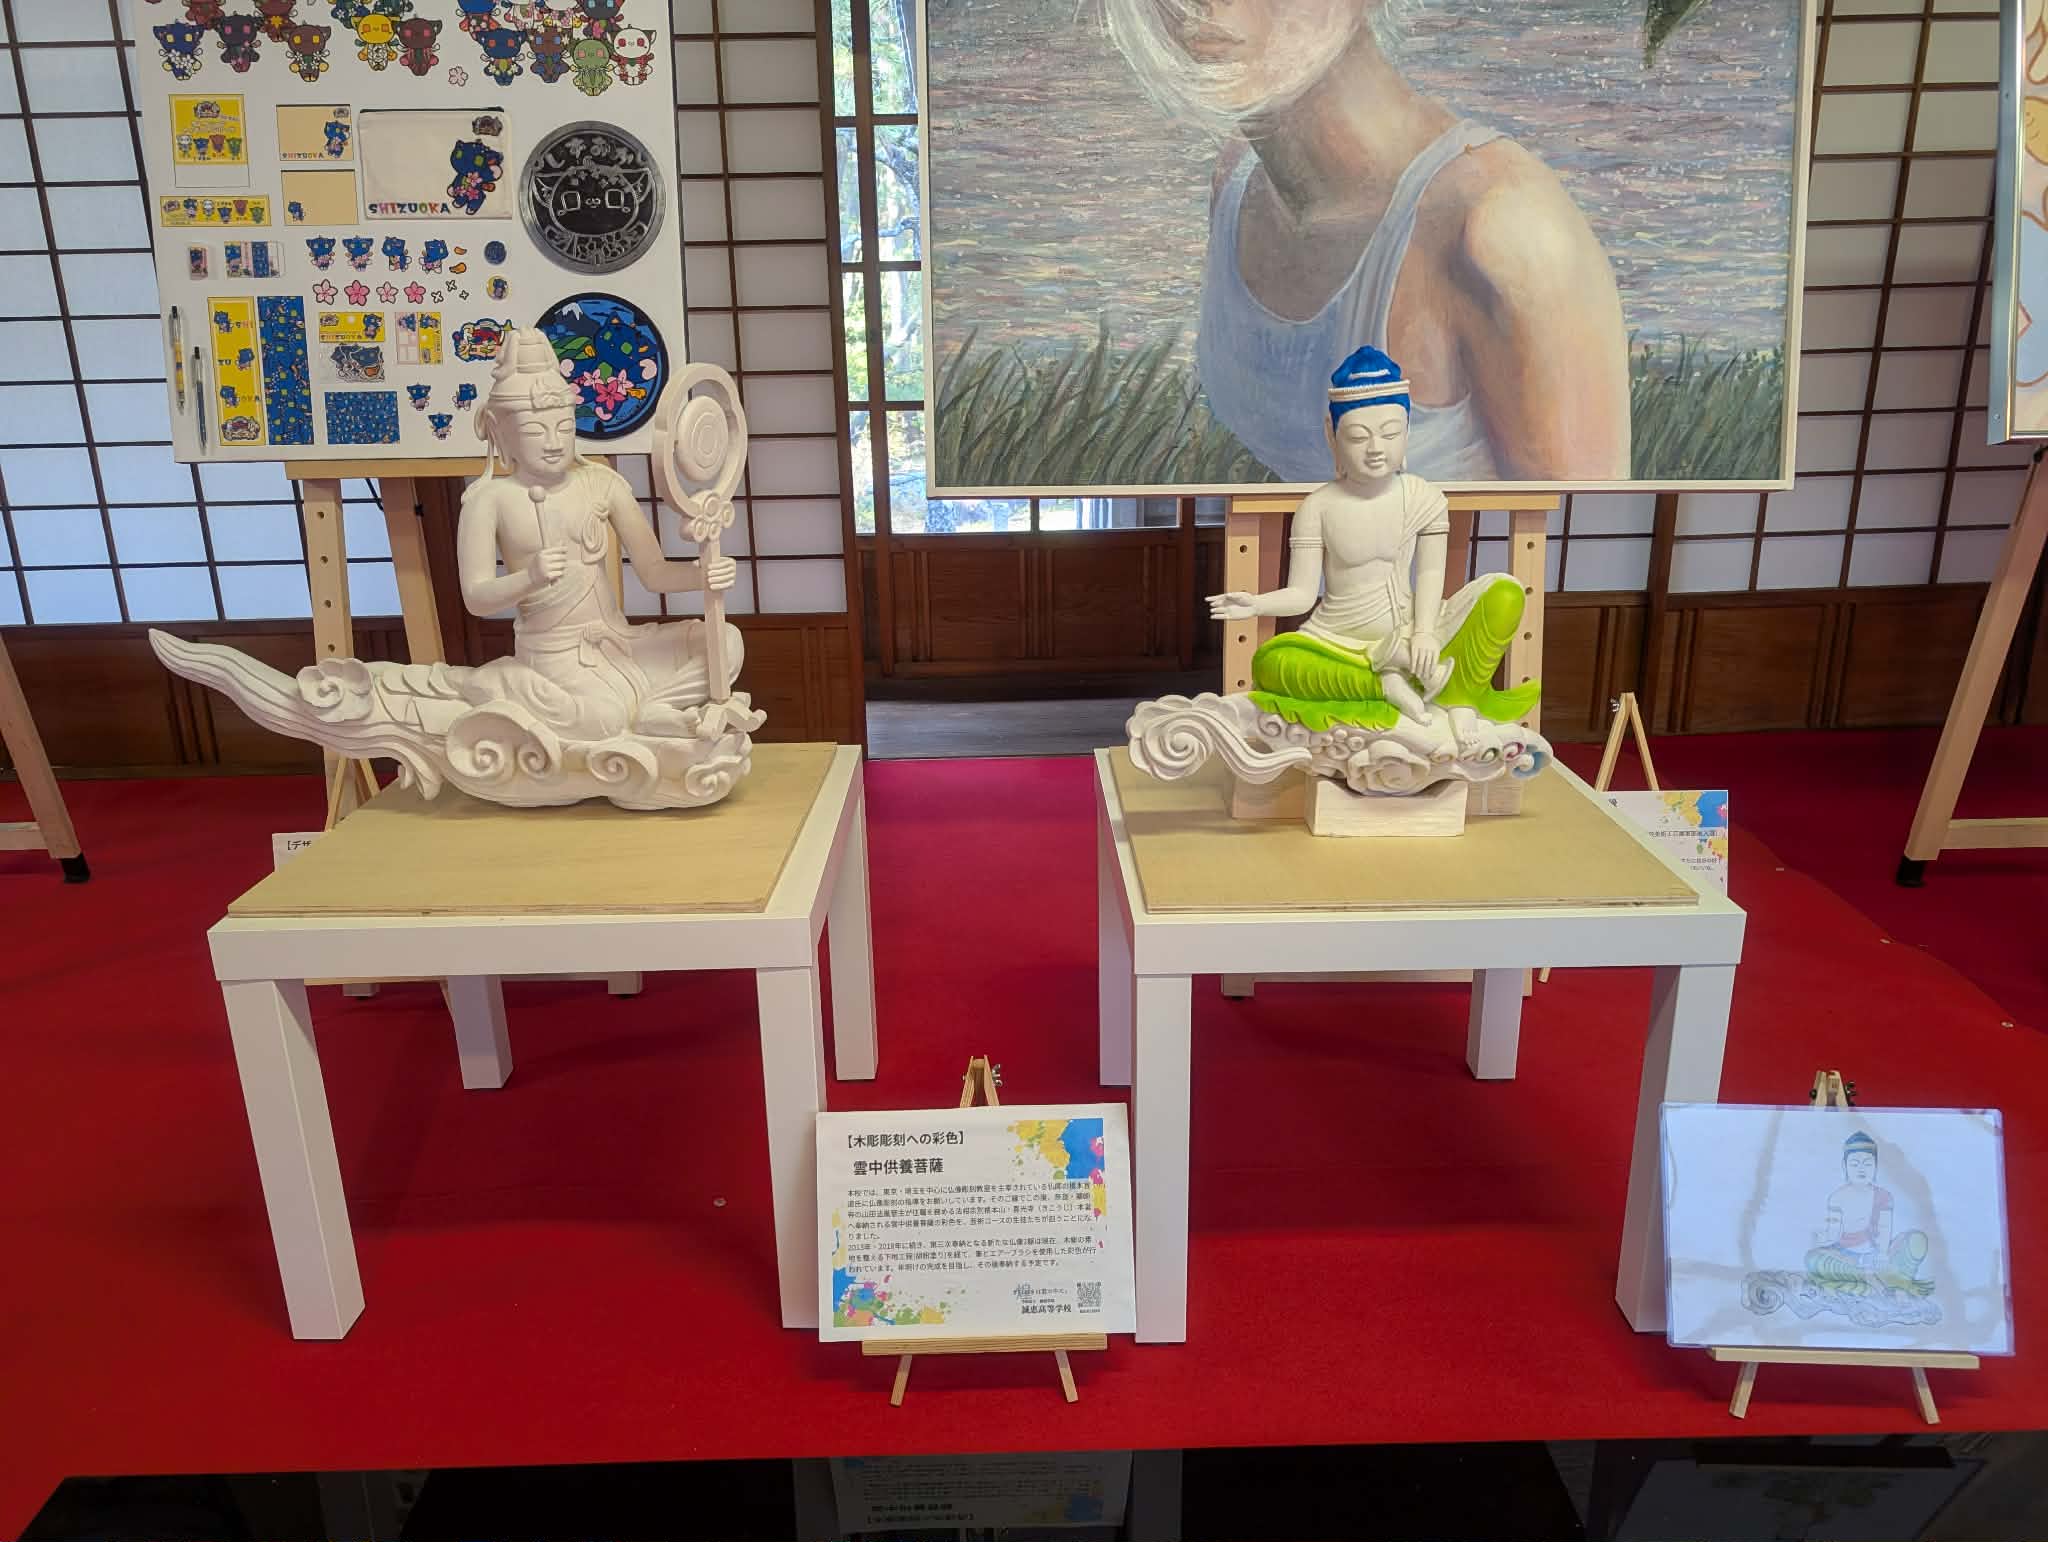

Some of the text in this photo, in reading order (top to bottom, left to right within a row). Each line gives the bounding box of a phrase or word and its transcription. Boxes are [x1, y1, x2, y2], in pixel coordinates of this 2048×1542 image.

[368, 203, 450, 214] SHIZUOKA
[847, 1130, 964, 1149] 【木彫彫刻への彩色】
[853, 1157, 944, 1176] 雲中供養菩薩
